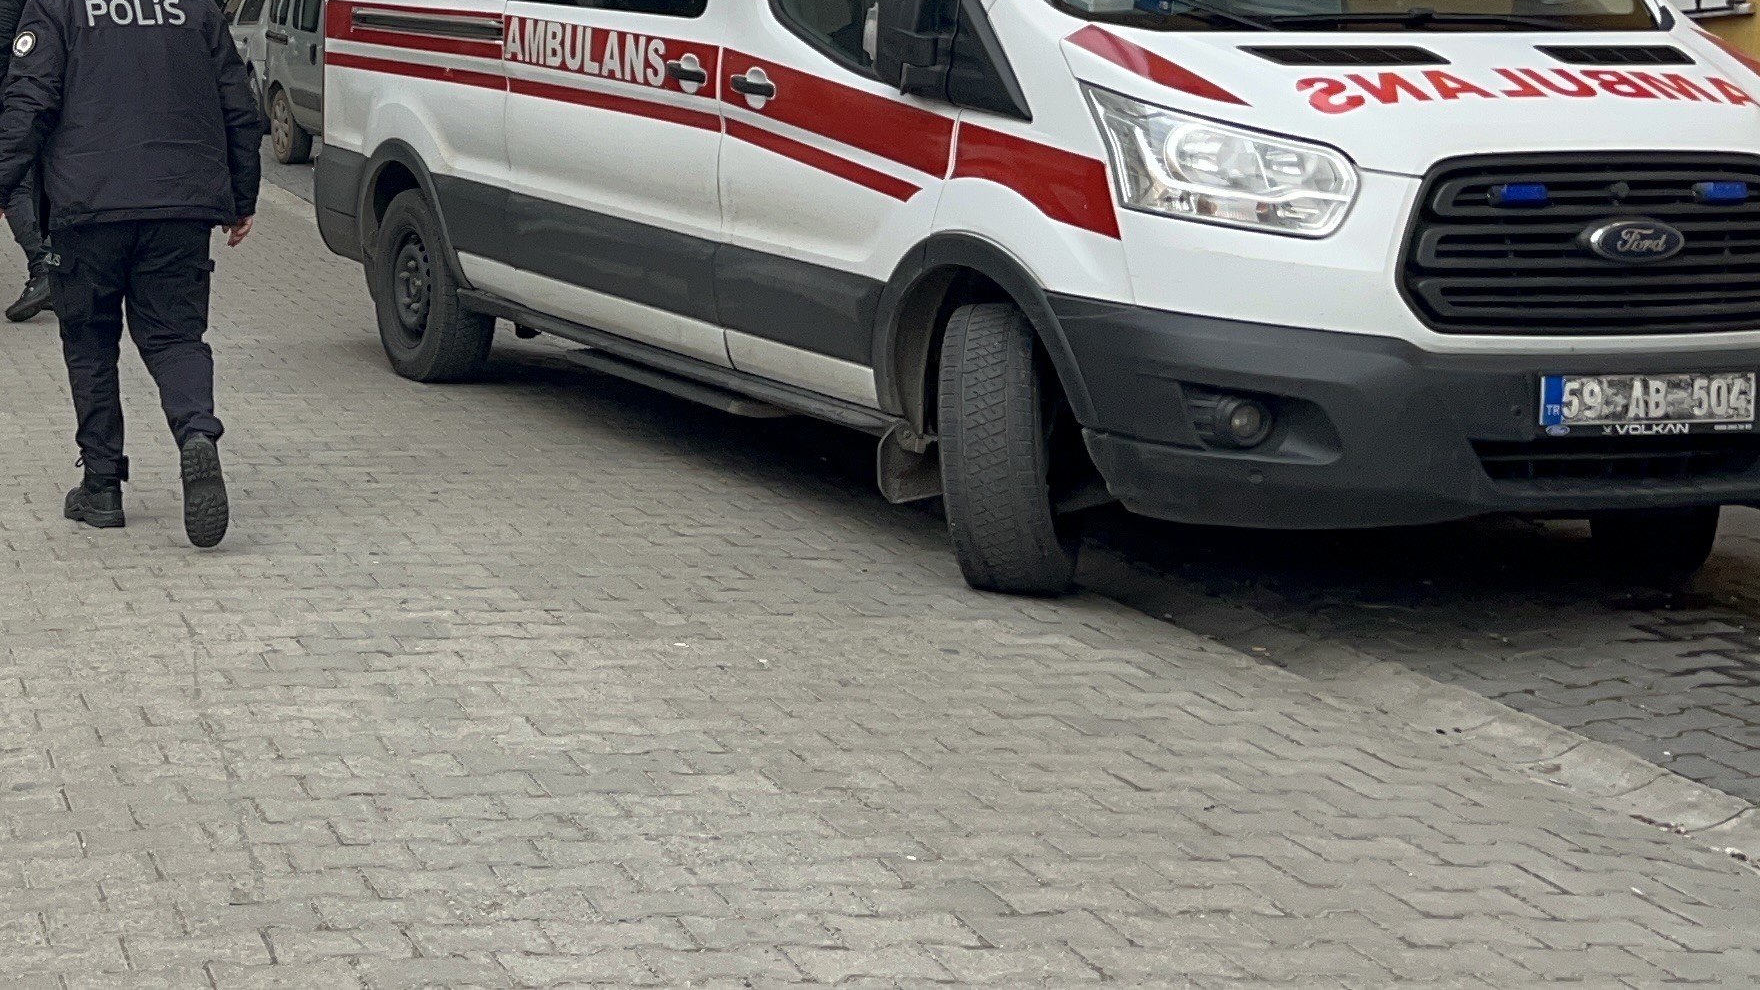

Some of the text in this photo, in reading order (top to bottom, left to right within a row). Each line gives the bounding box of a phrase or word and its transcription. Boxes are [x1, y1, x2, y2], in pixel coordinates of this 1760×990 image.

[504, 16, 666, 87] AMBULANS
[1616, 228, 1667, 252] Ford
[1563, 377, 1749, 418] 59 AB 504
[1546, 404, 1560, 416] TR
[1615, 423, 1690, 435] VOLKAN
